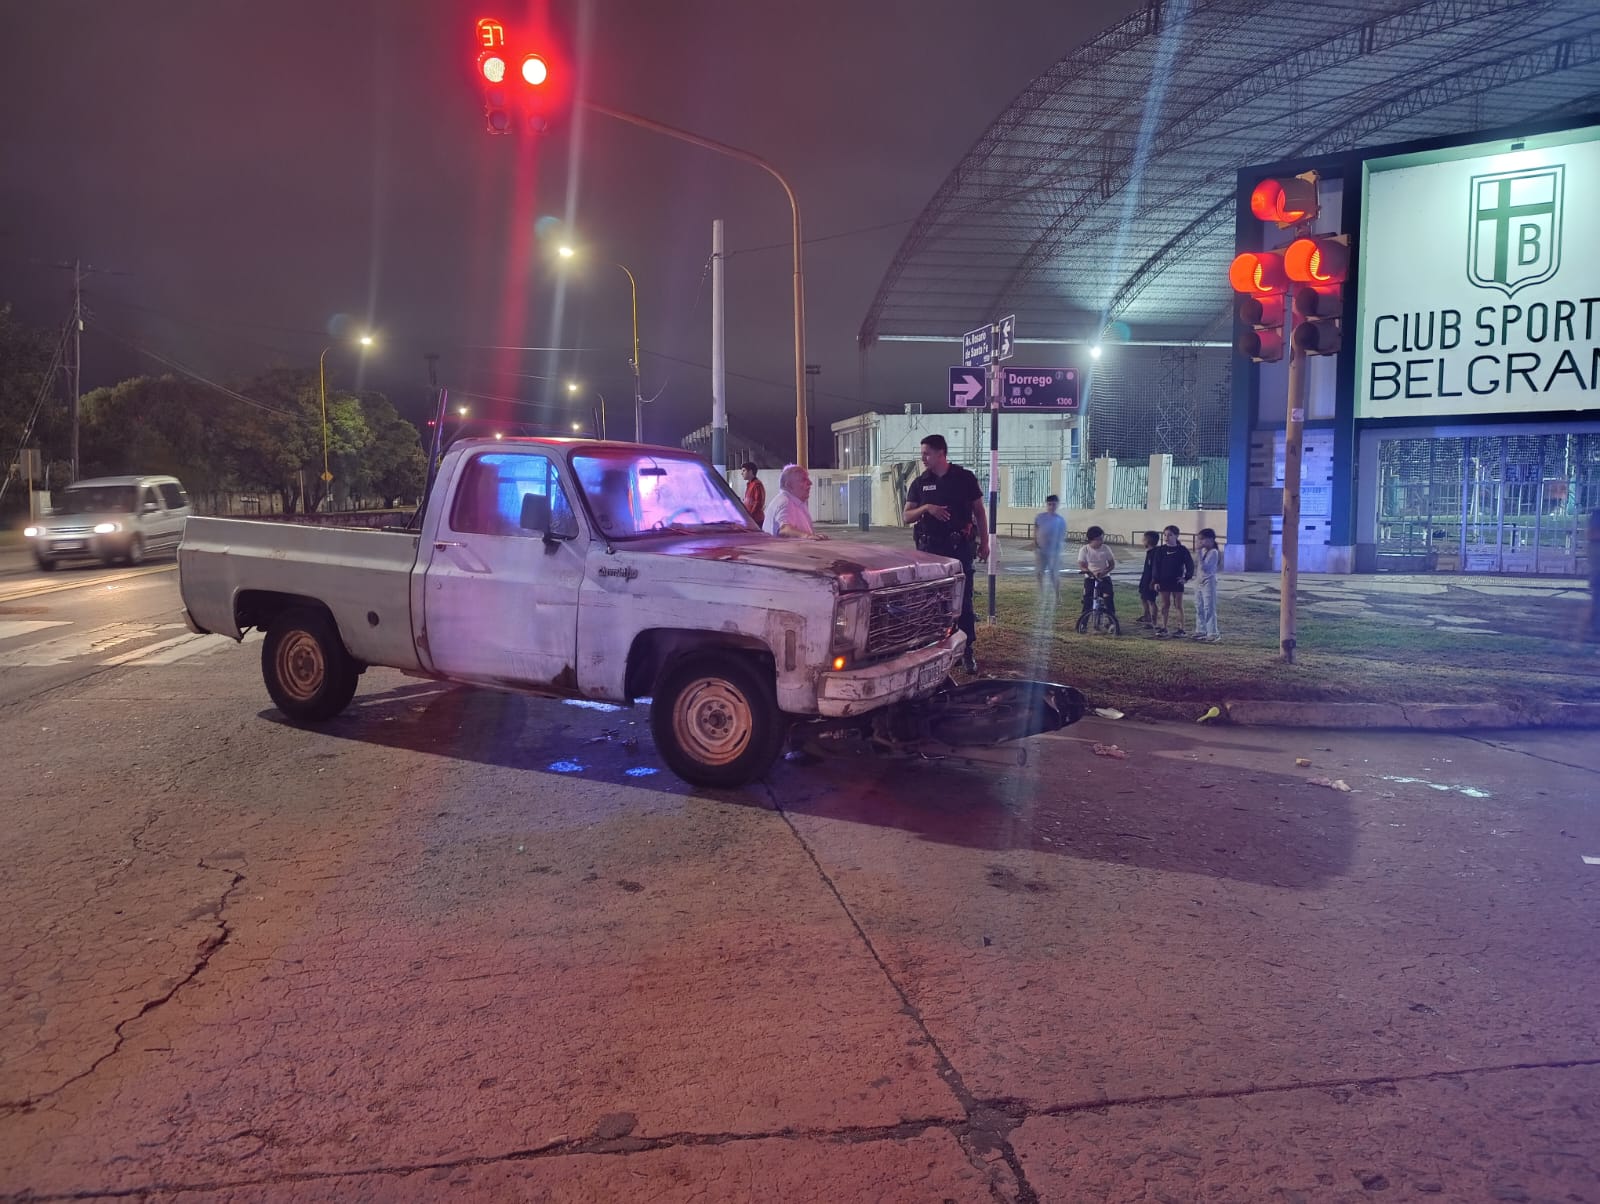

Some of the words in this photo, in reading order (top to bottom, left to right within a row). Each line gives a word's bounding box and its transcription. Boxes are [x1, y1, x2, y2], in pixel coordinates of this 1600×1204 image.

[482, 25, 504, 46] 37
[1518, 223, 1541, 266] B
[1373, 309, 1462, 354] CLUB
[1475, 297, 1600, 347] SPORT
[971, 345, 982, 357] Santa
[983, 342, 988, 352] Fe
[1008, 373, 1053, 387] Dorrego
[1009, 397, 1026, 405] 1400
[1056, 397, 1073, 405] 1300
